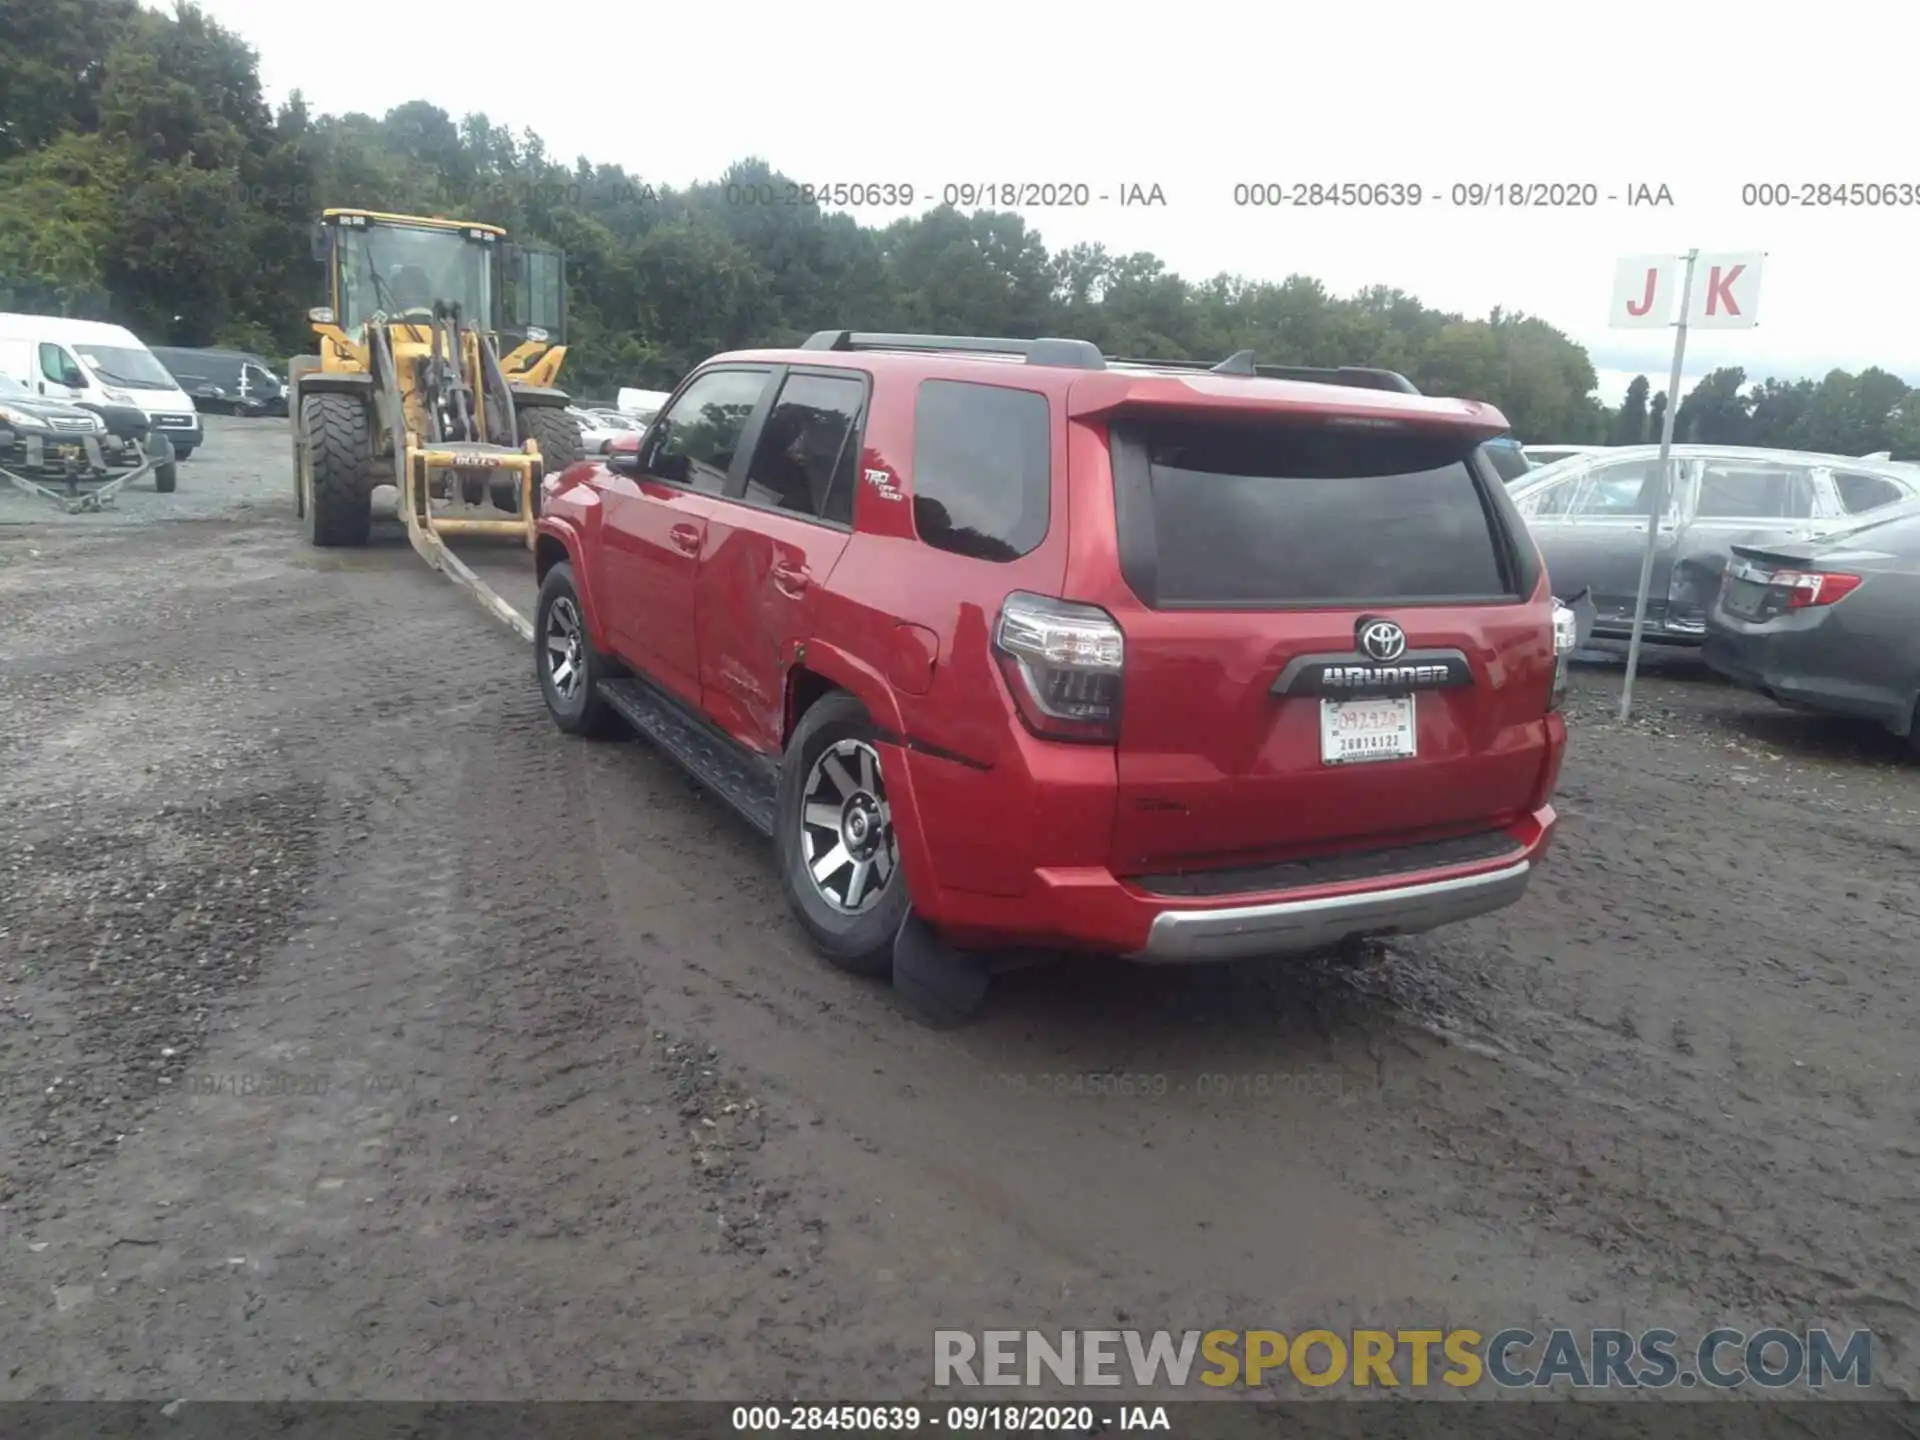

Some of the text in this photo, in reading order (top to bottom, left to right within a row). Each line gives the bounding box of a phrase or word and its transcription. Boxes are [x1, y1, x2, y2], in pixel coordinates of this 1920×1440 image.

[1626, 267, 1658, 317] J
[1703, 263, 1748, 317] K
[864, 467, 891, 486] TRD
[1322, 664, 1449, 688] 4RUNNER
